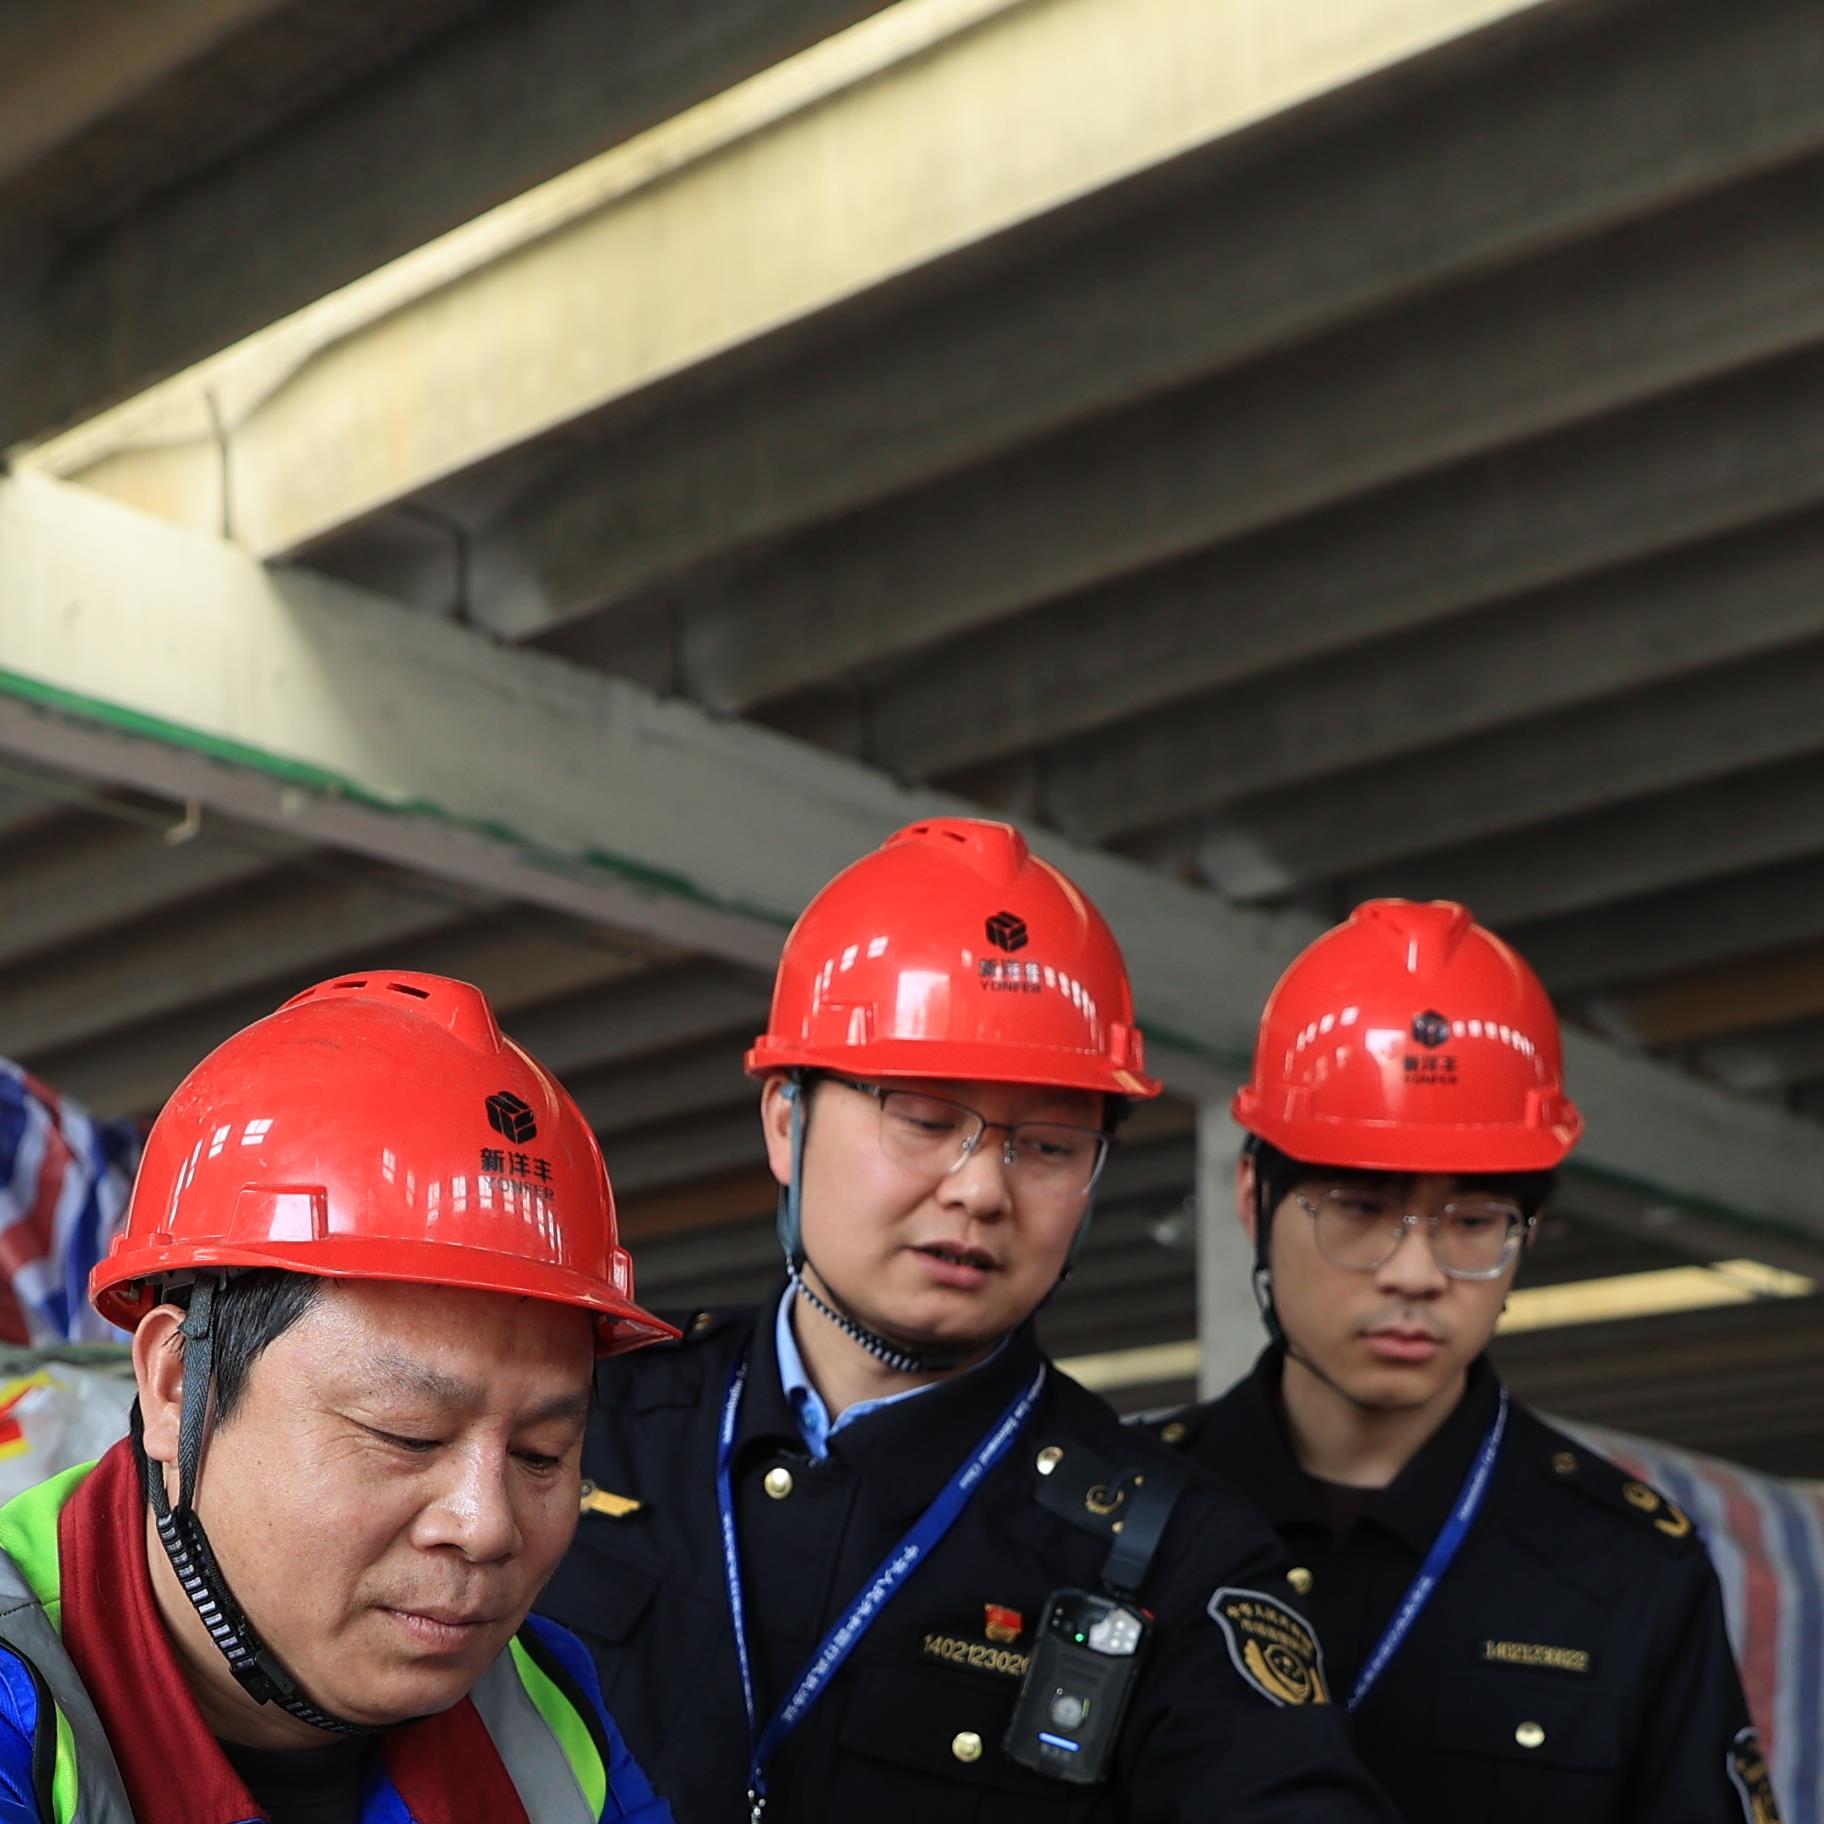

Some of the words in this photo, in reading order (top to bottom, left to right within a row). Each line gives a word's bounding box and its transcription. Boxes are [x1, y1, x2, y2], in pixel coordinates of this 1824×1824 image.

[480, 1147, 553, 1183] 新洋丰
[483, 1175, 555, 1201] YONFER
